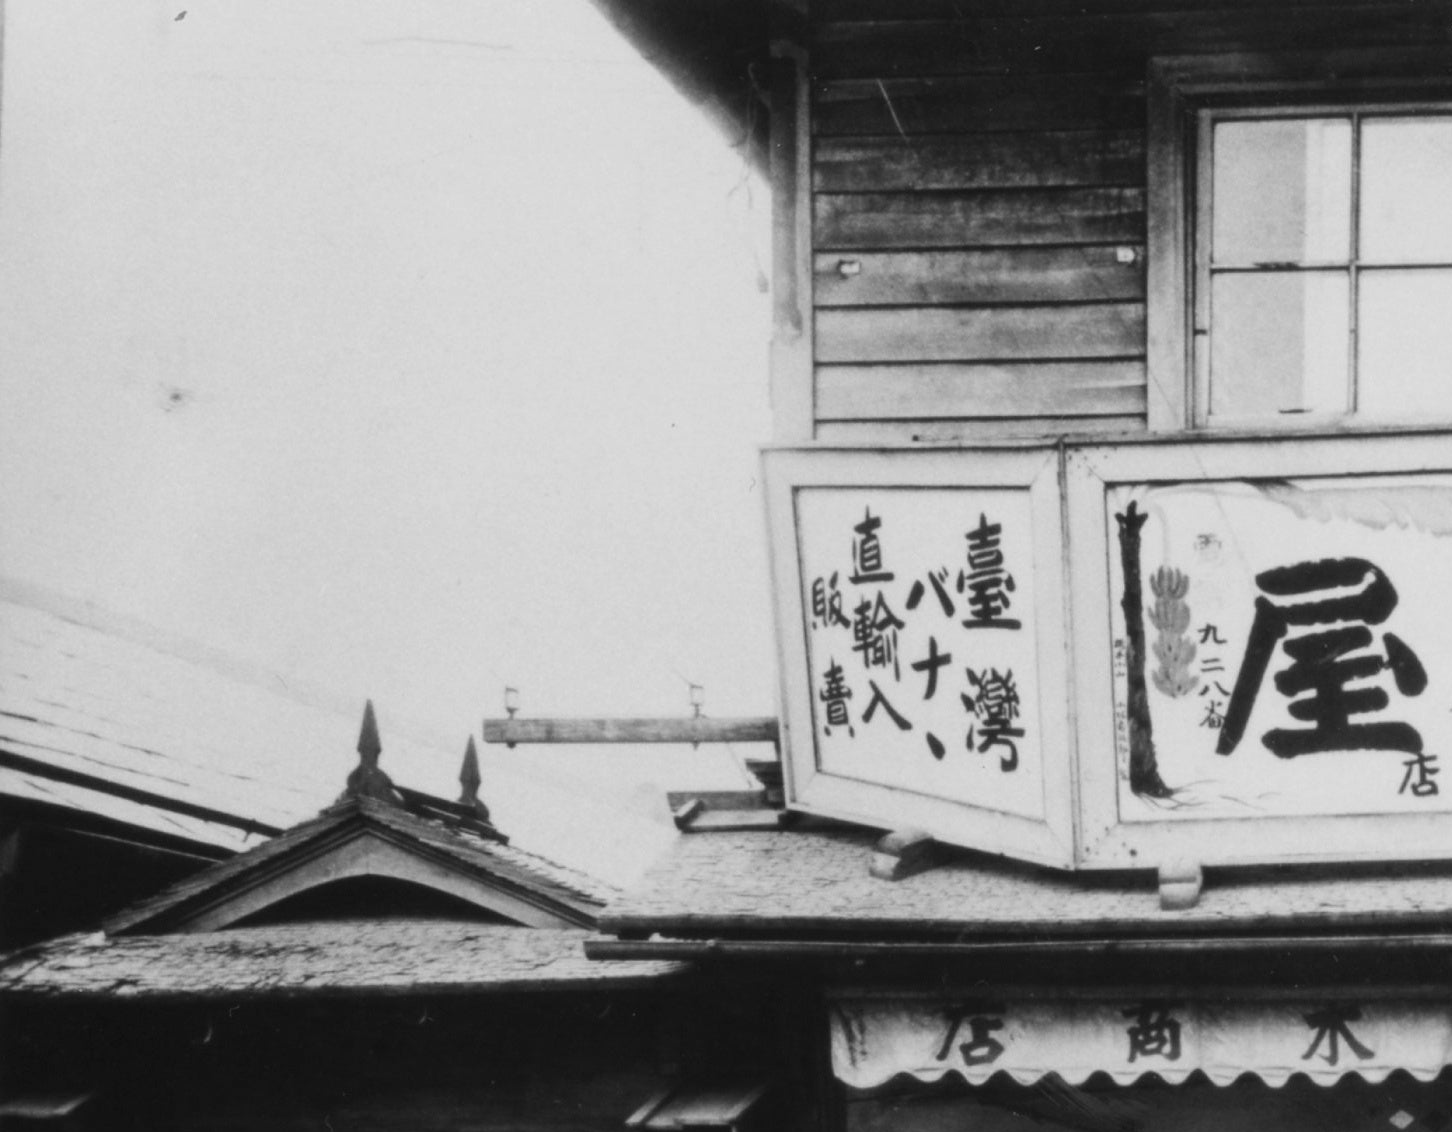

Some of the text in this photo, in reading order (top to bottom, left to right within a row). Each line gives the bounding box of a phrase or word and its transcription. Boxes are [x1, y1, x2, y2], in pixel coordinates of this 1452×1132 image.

[811, 570, 856, 740] 販賣
[848, 504, 913, 733] 直輸入
[957, 512, 1026, 774] 臺灣
